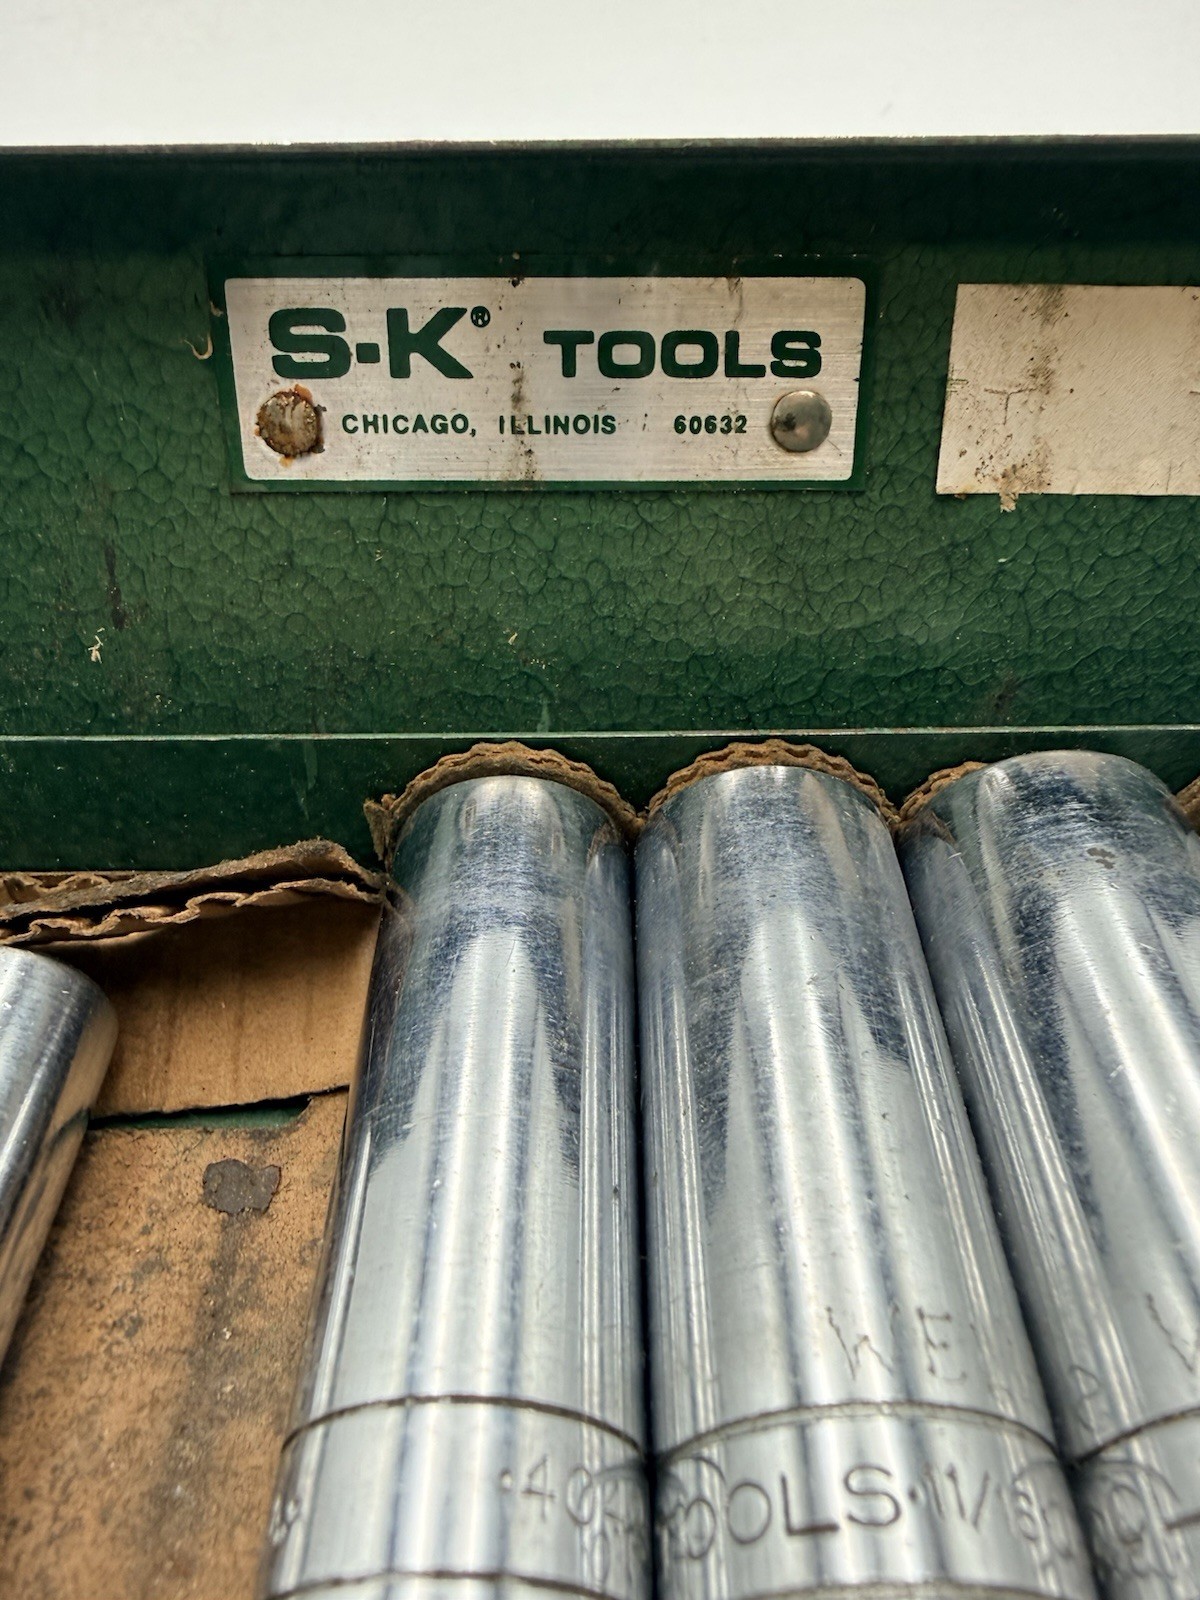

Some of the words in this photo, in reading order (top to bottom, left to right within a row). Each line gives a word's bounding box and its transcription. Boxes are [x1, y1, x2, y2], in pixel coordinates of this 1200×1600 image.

[543, 330, 822, 378] TOOLS
[342, 414, 477, 437] CHICAGO,
[499, 414, 617, 435] ILLINOIS
[674, 415, 747, 434] 60632
